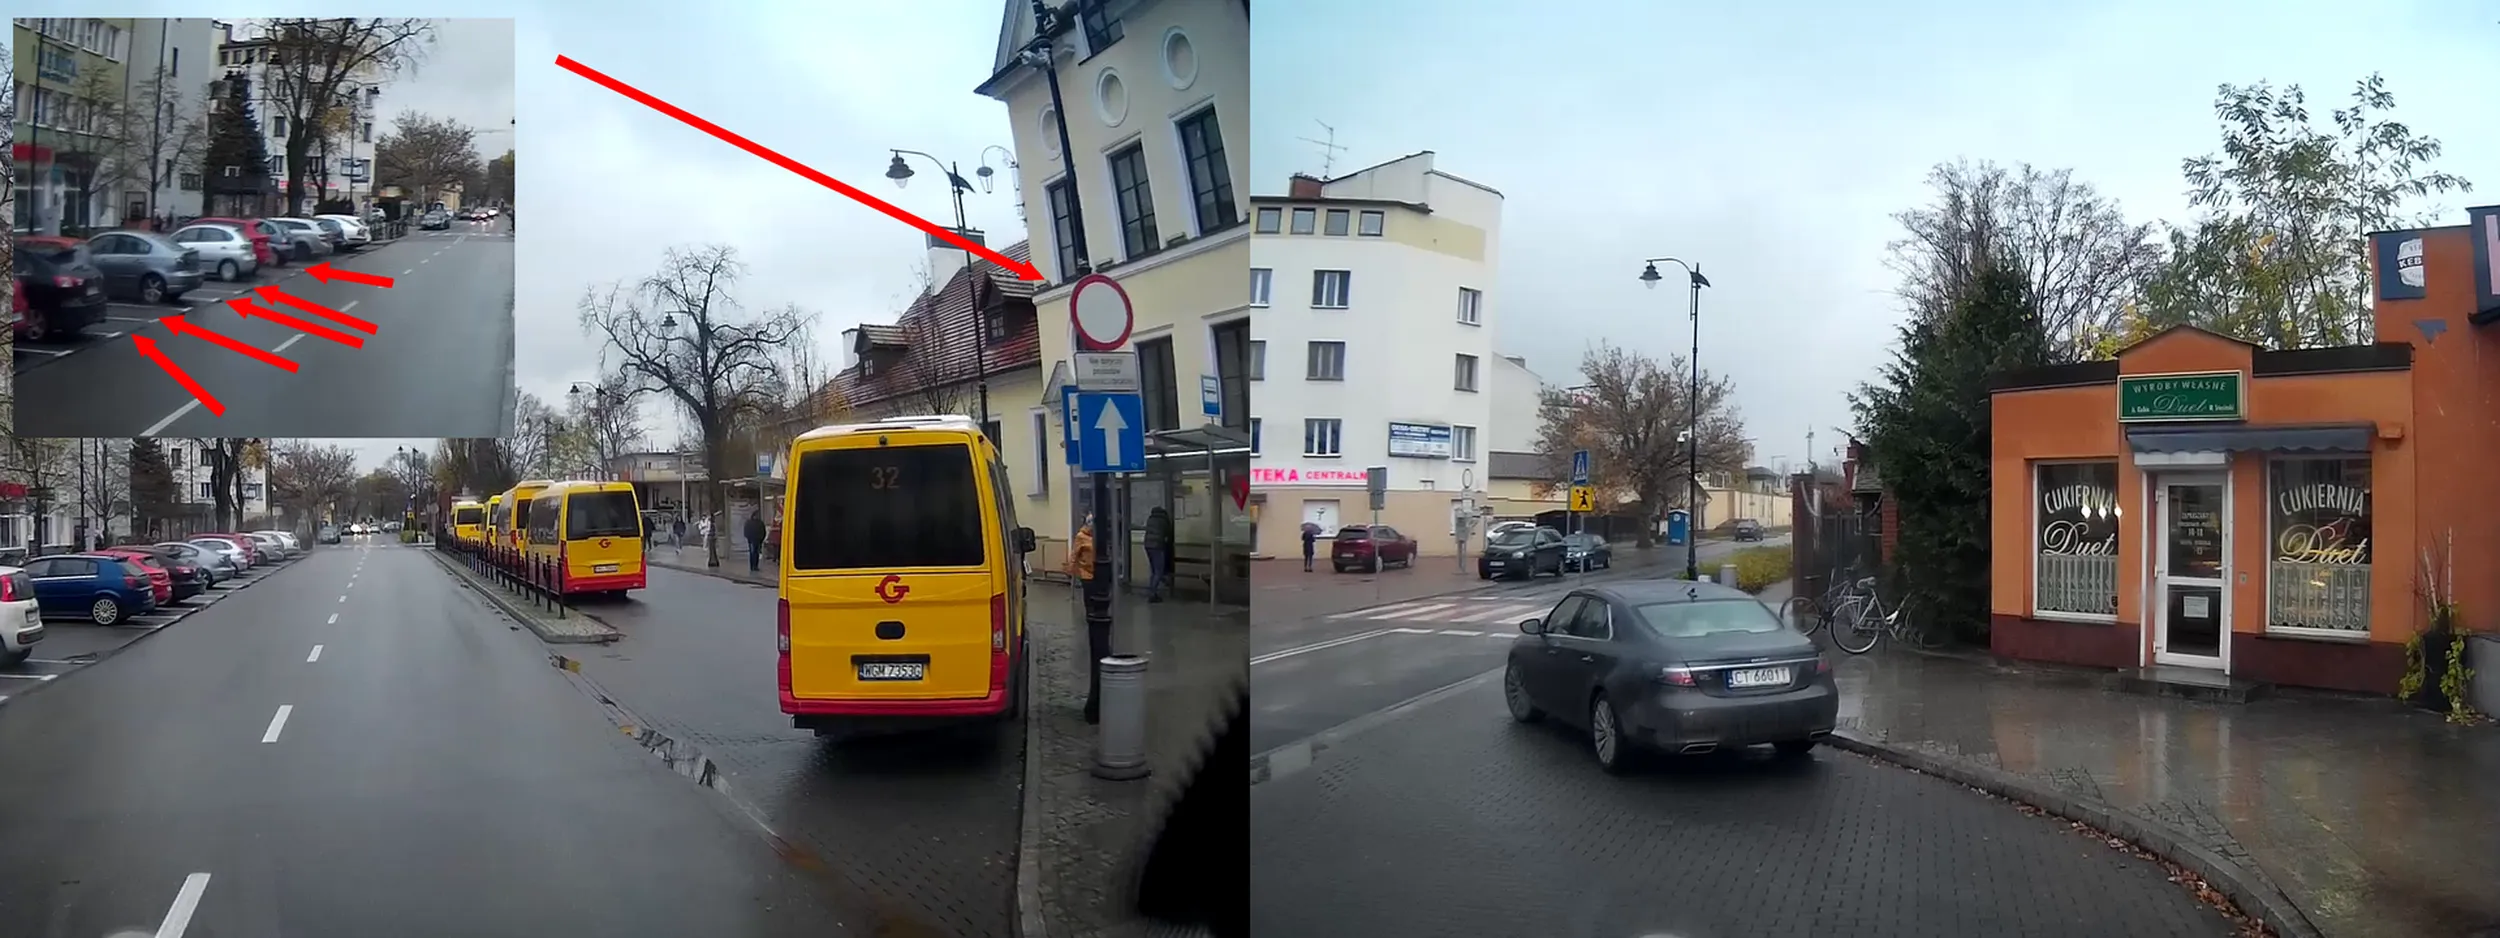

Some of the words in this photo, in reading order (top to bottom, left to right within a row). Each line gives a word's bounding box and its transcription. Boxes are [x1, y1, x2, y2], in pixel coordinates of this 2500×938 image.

[2132, 381, 2178, 394] WYROBY
[2181, 380, 2227, 391] WŁASNE
[2152, 393, 2208, 413] Duet
[871, 466, 900, 490] 32
[1250, 469, 1299, 482] TEKA
[2044, 484, 2114, 515] CUKIERNIA
[2280, 483, 2365, 517] CUKIERNIA
[2043, 520, 2115, 556] Duet
[2278, 524, 2369, 565] Duet
[1734, 671, 1750, 684] CT
[1754, 668, 1787, 682] 6601T
